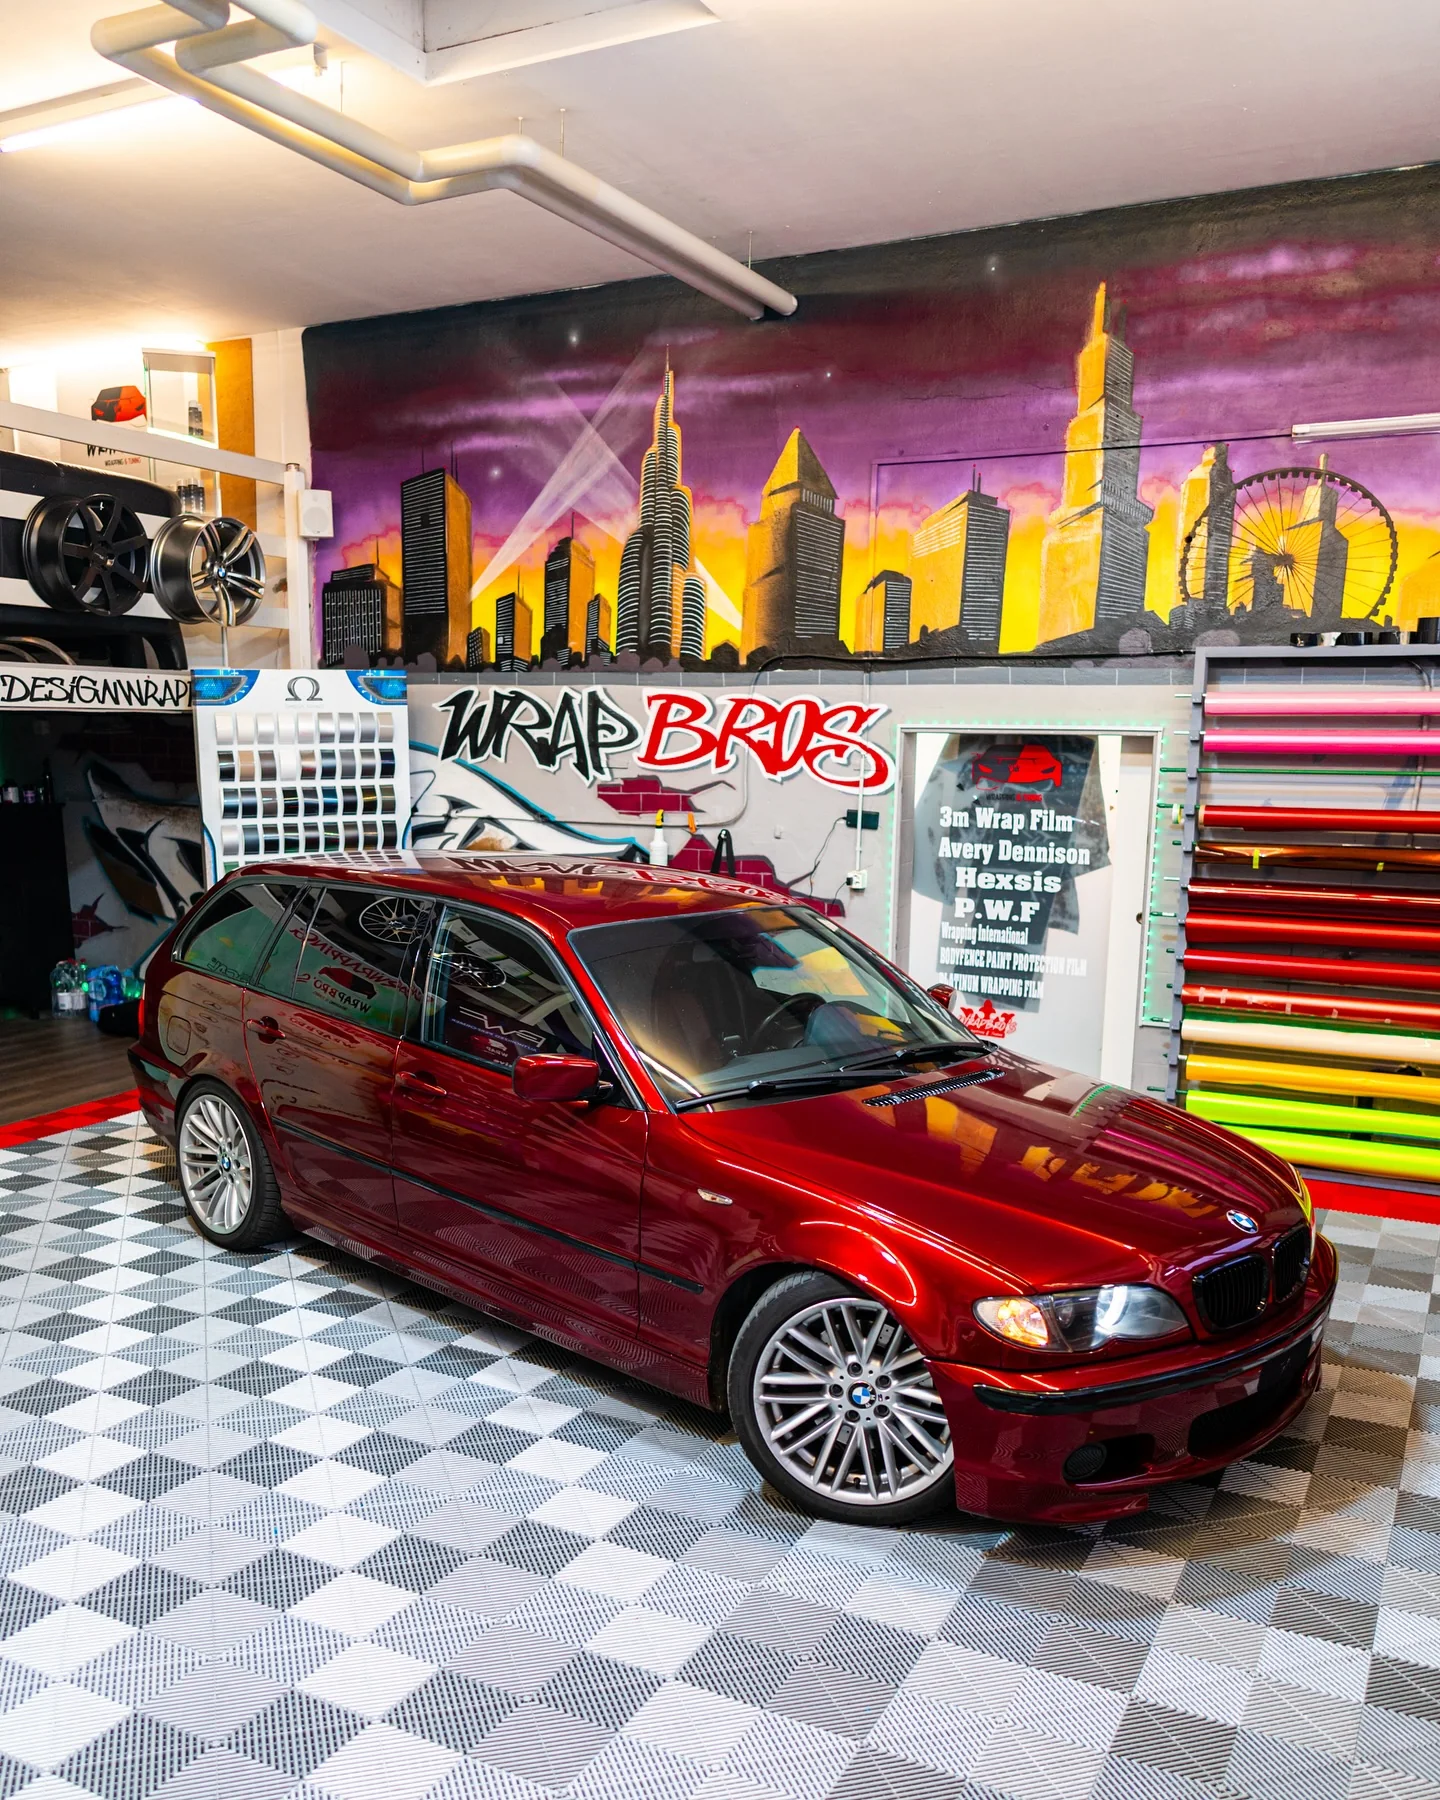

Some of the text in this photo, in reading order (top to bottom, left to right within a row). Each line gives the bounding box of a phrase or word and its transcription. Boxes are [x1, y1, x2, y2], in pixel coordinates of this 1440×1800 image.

[435, 686, 895, 794] WRAP BROS
[939, 806, 1073, 835] 3m Wrap Film
[938, 837, 1090, 865] Avery Dennison
[955, 867, 1062, 893] Hexsis
[954, 897, 1040, 923] P.W.F
[941, 922, 1029, 945] Wrapping International
[940, 947, 1087, 977] BODYFENCE PAINT PROTECTION FILM
[980, 975, 1024, 997] WRAPPING
[1024, 980, 1044, 999] FILM
